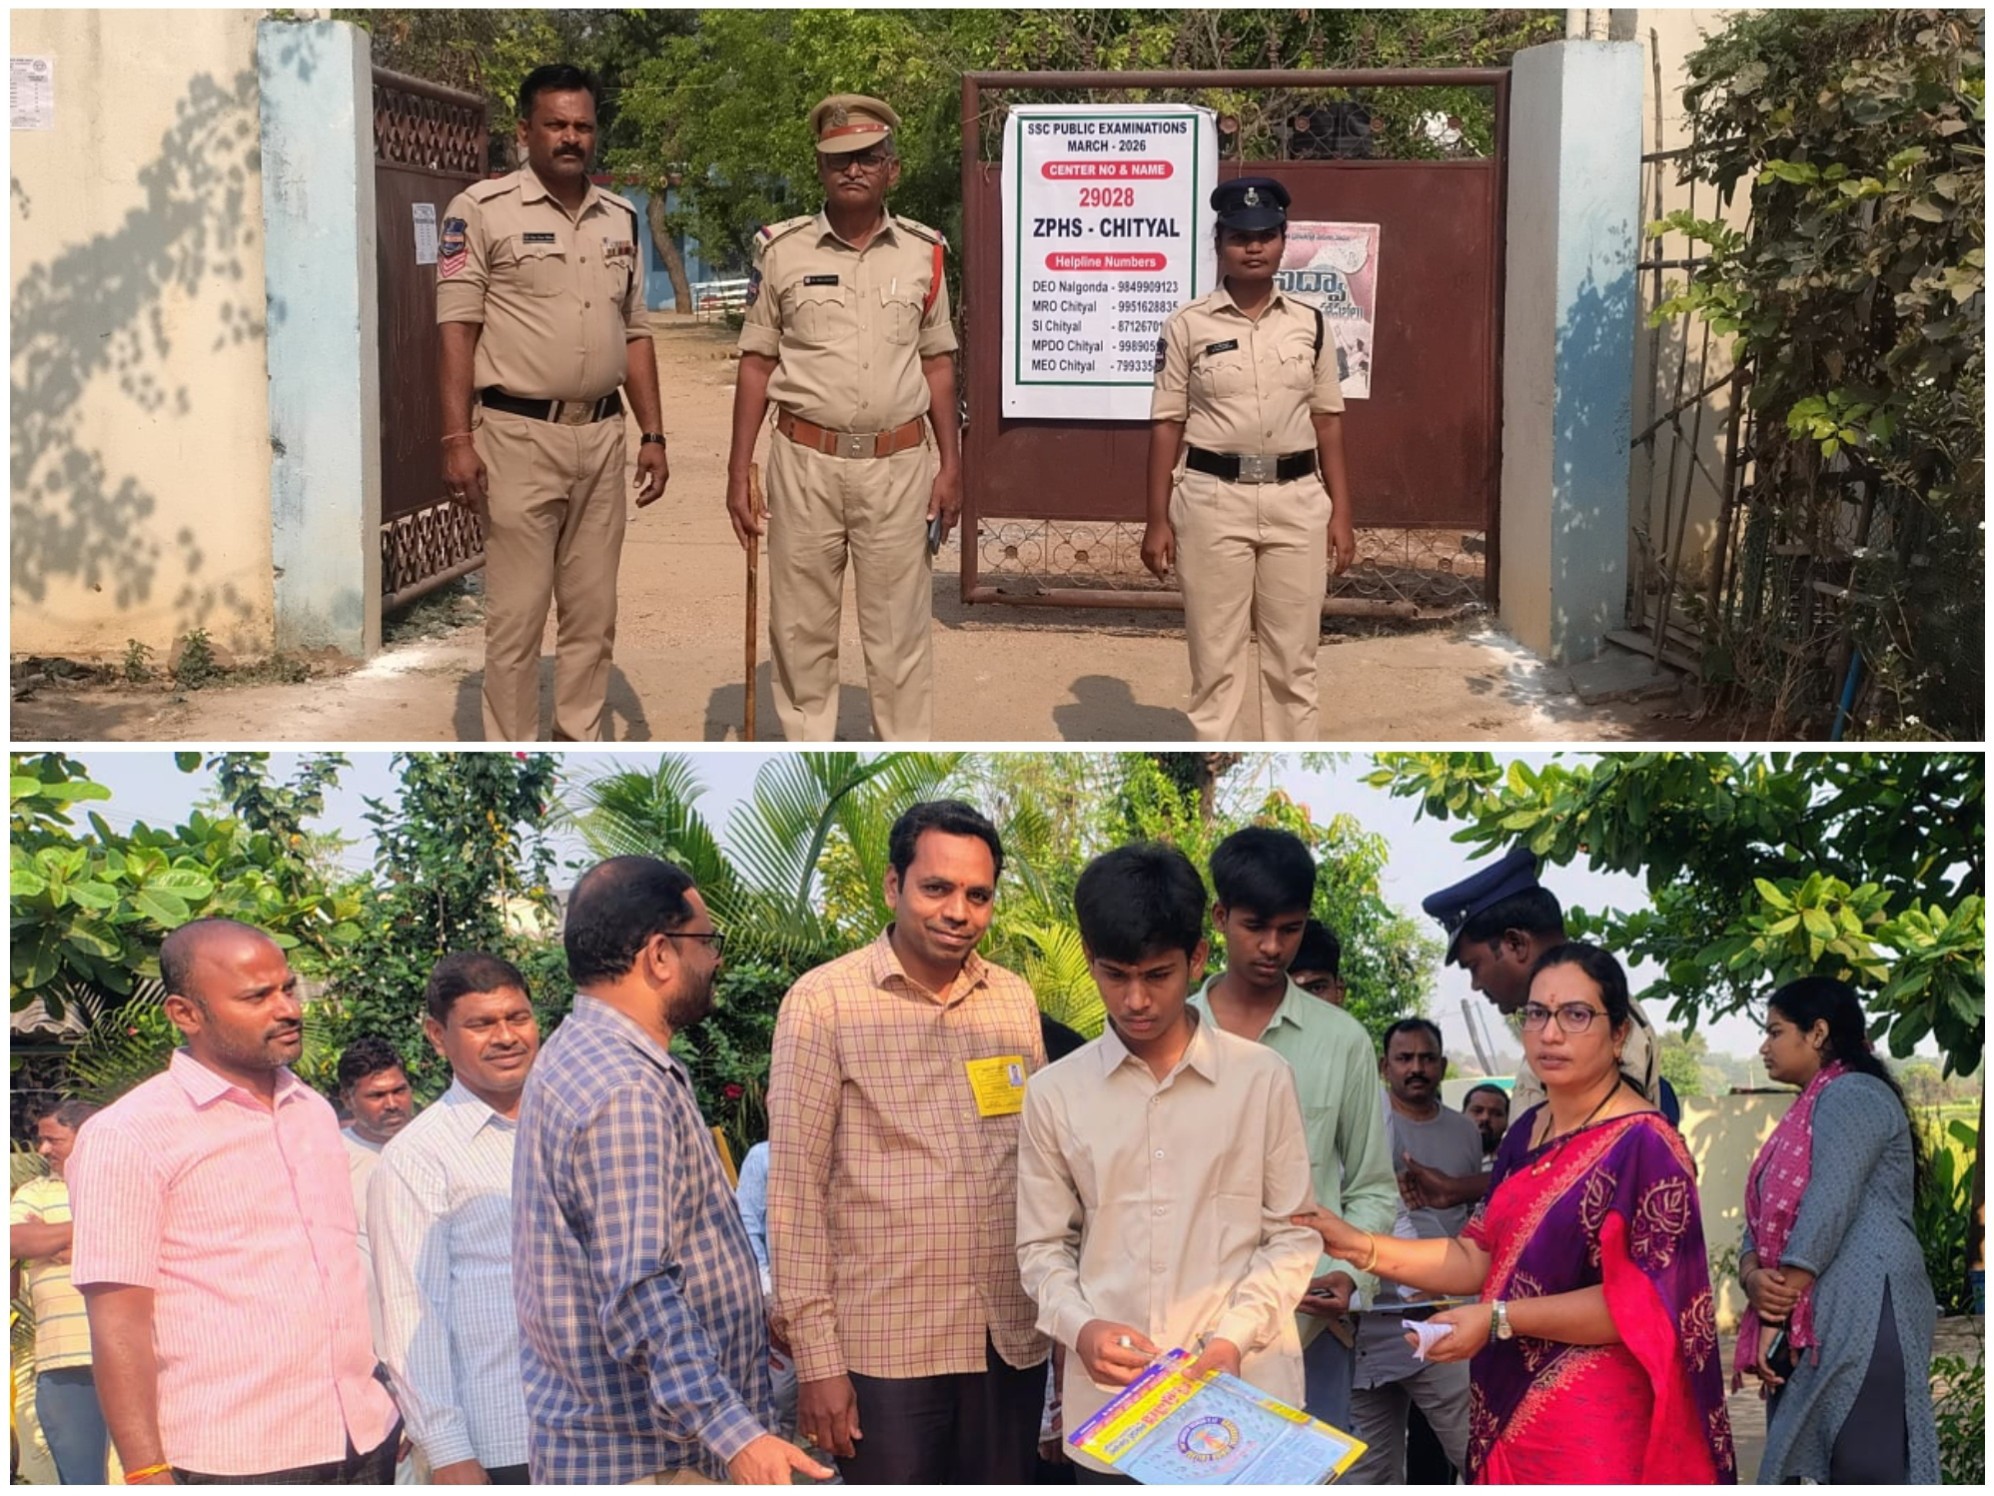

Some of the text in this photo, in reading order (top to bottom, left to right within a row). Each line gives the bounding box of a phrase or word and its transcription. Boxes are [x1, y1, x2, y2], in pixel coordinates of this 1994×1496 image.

[1028, 122, 1187, 135] SSC PUBLIC EXAMINATIONS
[1067, 140, 1108, 152] MARCH
[1119, 140, 1146, 152] 2026
[1050, 164, 1166, 176] CENTER NO & NAME
[1079, 187, 1134, 207] 29028
[1033, 218, 1083, 237] ZPHS
[1099, 218, 1180, 237] CHITYAL
[1055, 256, 1156, 269] Helpline Numbers
[1033, 281, 1056, 292] DEO
[1059, 281, 1108, 296] Nalgonda
[1117, 281, 1178, 293] 9849909123
[1032, 300, 1058, 312] MRO
[1060, 300, 1096, 315] Chityal
[1118, 300, 1178, 312] 9951628835
[1032, 320, 1043, 331] SI
[1045, 320, 1082, 334] Chityal
[1032, 340, 1064, 351] MPDO
[1067, 340, 1103, 354] Chityal
[1118, 340, 1157, 352] 998905
[1032, 360, 1056, 371] MEO
[1059, 360, 1095, 374] Chityal
[1116, 360, 1155, 372] 799335
